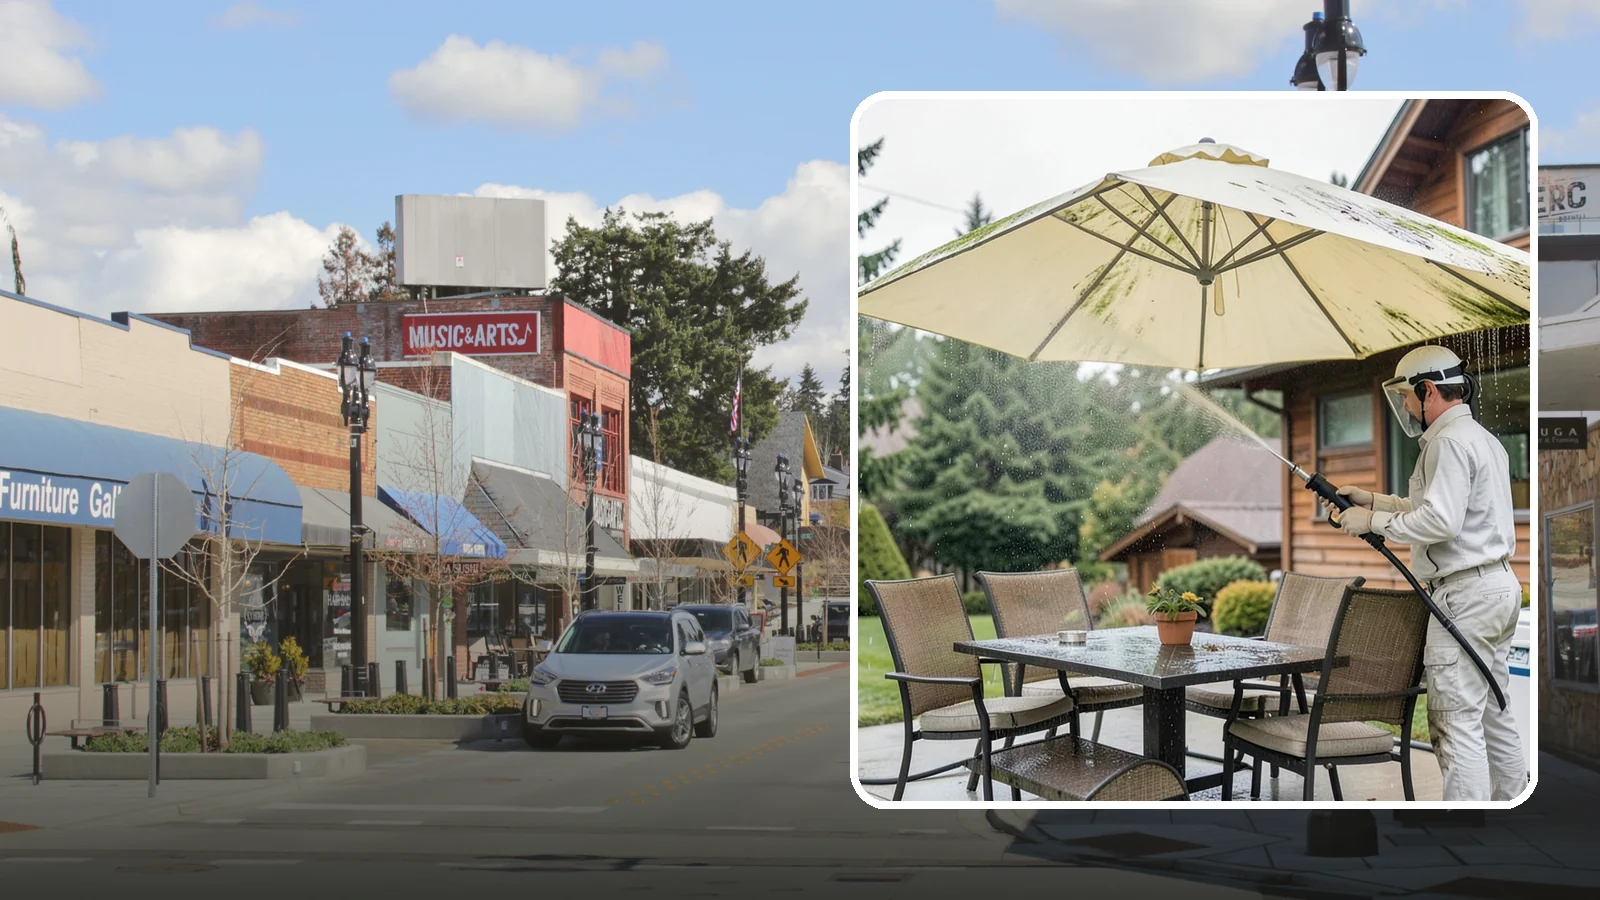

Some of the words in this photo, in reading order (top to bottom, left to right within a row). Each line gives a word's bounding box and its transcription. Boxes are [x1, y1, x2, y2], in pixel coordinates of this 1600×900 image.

[409, 323, 519, 349] MUSIC&ARTS
[1540, 427, 1578, 437] UGA
[0, 472, 79, 516] Furniture
